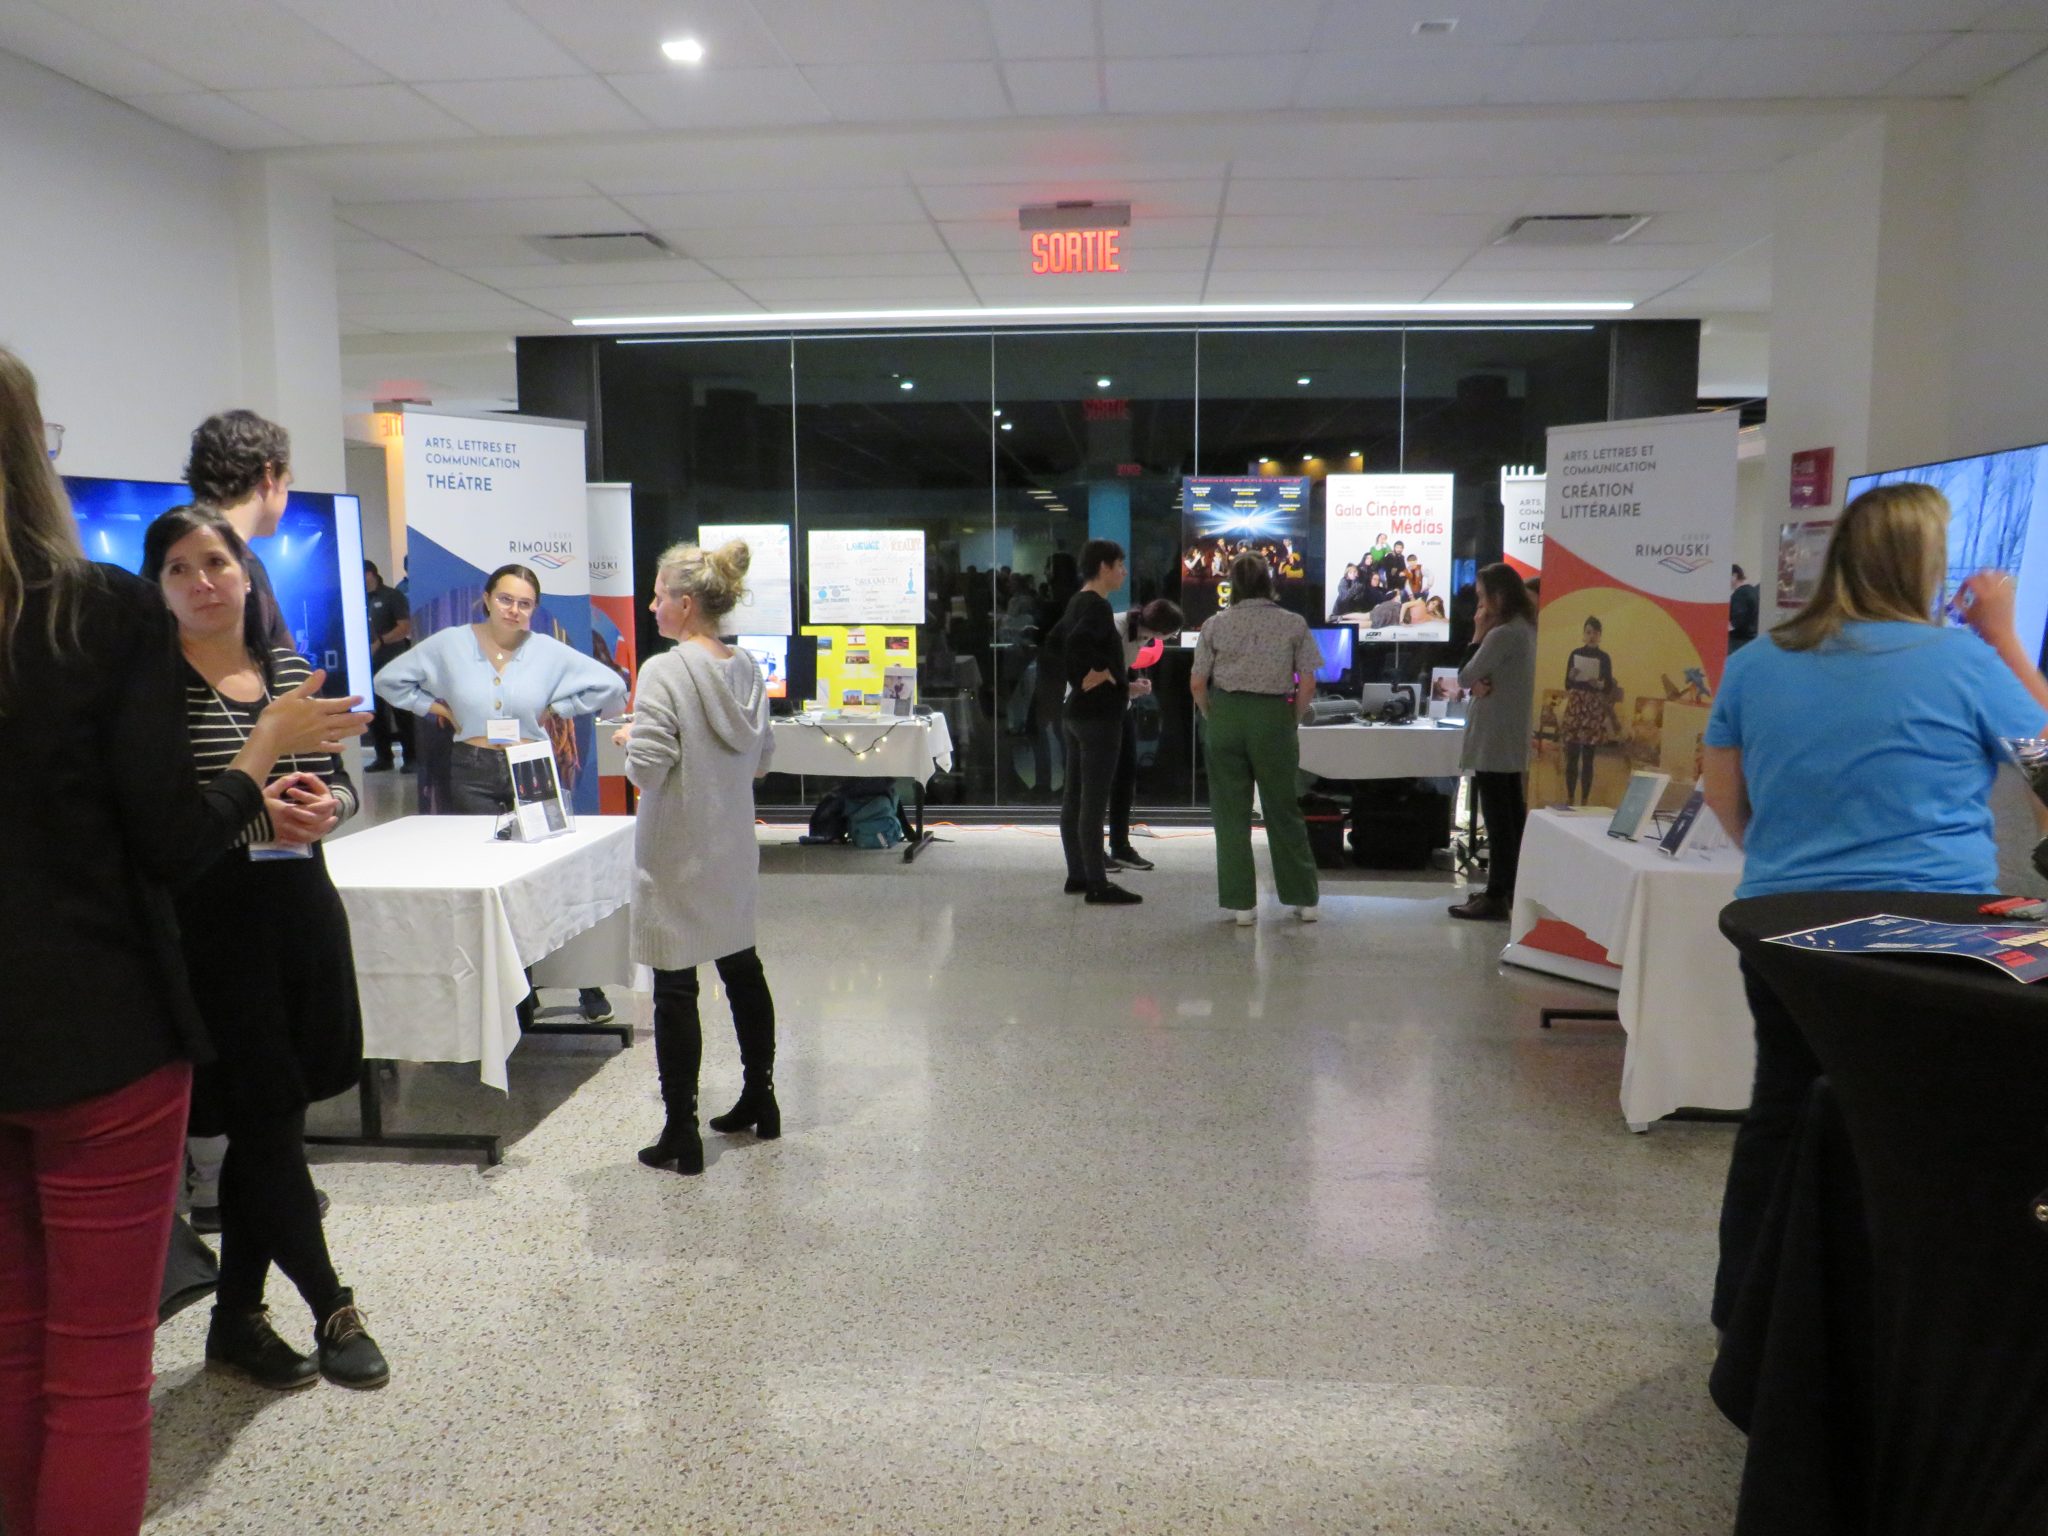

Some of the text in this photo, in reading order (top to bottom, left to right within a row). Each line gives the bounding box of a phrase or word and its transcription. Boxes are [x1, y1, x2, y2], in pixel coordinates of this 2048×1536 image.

[1032, 230, 1120, 273] SORTIE
[457, 440, 501, 453] LETTRES
[505, 443, 517, 454] ET
[1593, 447, 1638, 461] LETTRES
[1641, 445, 1654, 457] ET
[425, 453, 521, 469] COMMUNICATION
[1562, 461, 1656, 476] COMMUNICATION
[427, 472, 493, 491] THÉÂTRE
[1561, 482, 1634, 499] CRÉATION
[1335, 504, 1362, 517] Gala
[1366, 500, 1421, 517] Cinéma
[1561, 499, 1641, 519] LITTÉRAIRE
[1391, 519, 1444, 534] Médias
[509, 540, 572, 553] RIMOUSKI
[1635, 544, 1710, 557] RIMOUSKI
